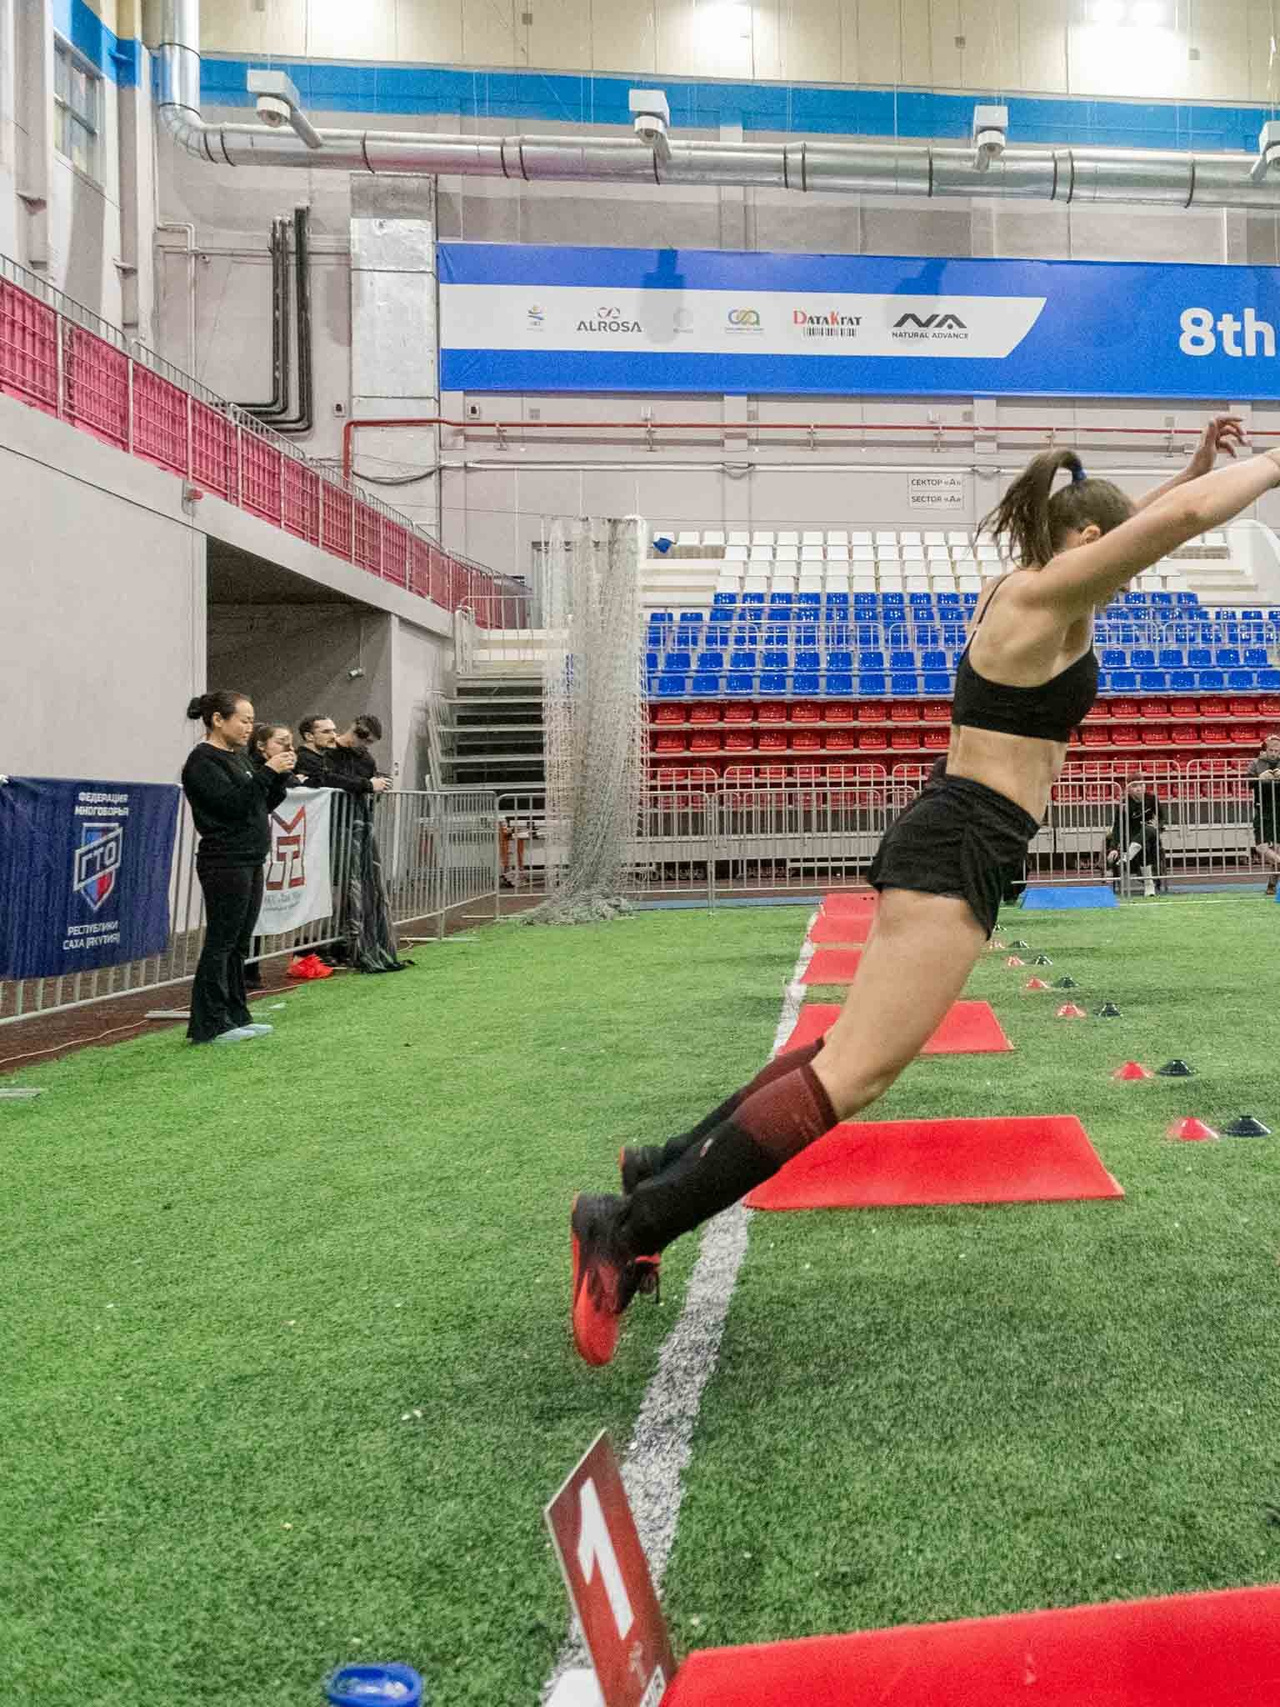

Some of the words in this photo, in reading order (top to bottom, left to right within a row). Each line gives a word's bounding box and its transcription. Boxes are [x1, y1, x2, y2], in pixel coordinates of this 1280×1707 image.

[577, 320, 642, 333] ALROSA
[1179, 307, 1276, 357] 8th
[892, 331, 929, 339] NATURAL
[932, 332, 968, 340] ADVANCE
[911, 478, 942, 486] СЕКТОР
[911, 495, 942, 503] SECTOR
[80, 841, 117, 880] ГТО
[577, 1477, 634, 1640] 1
